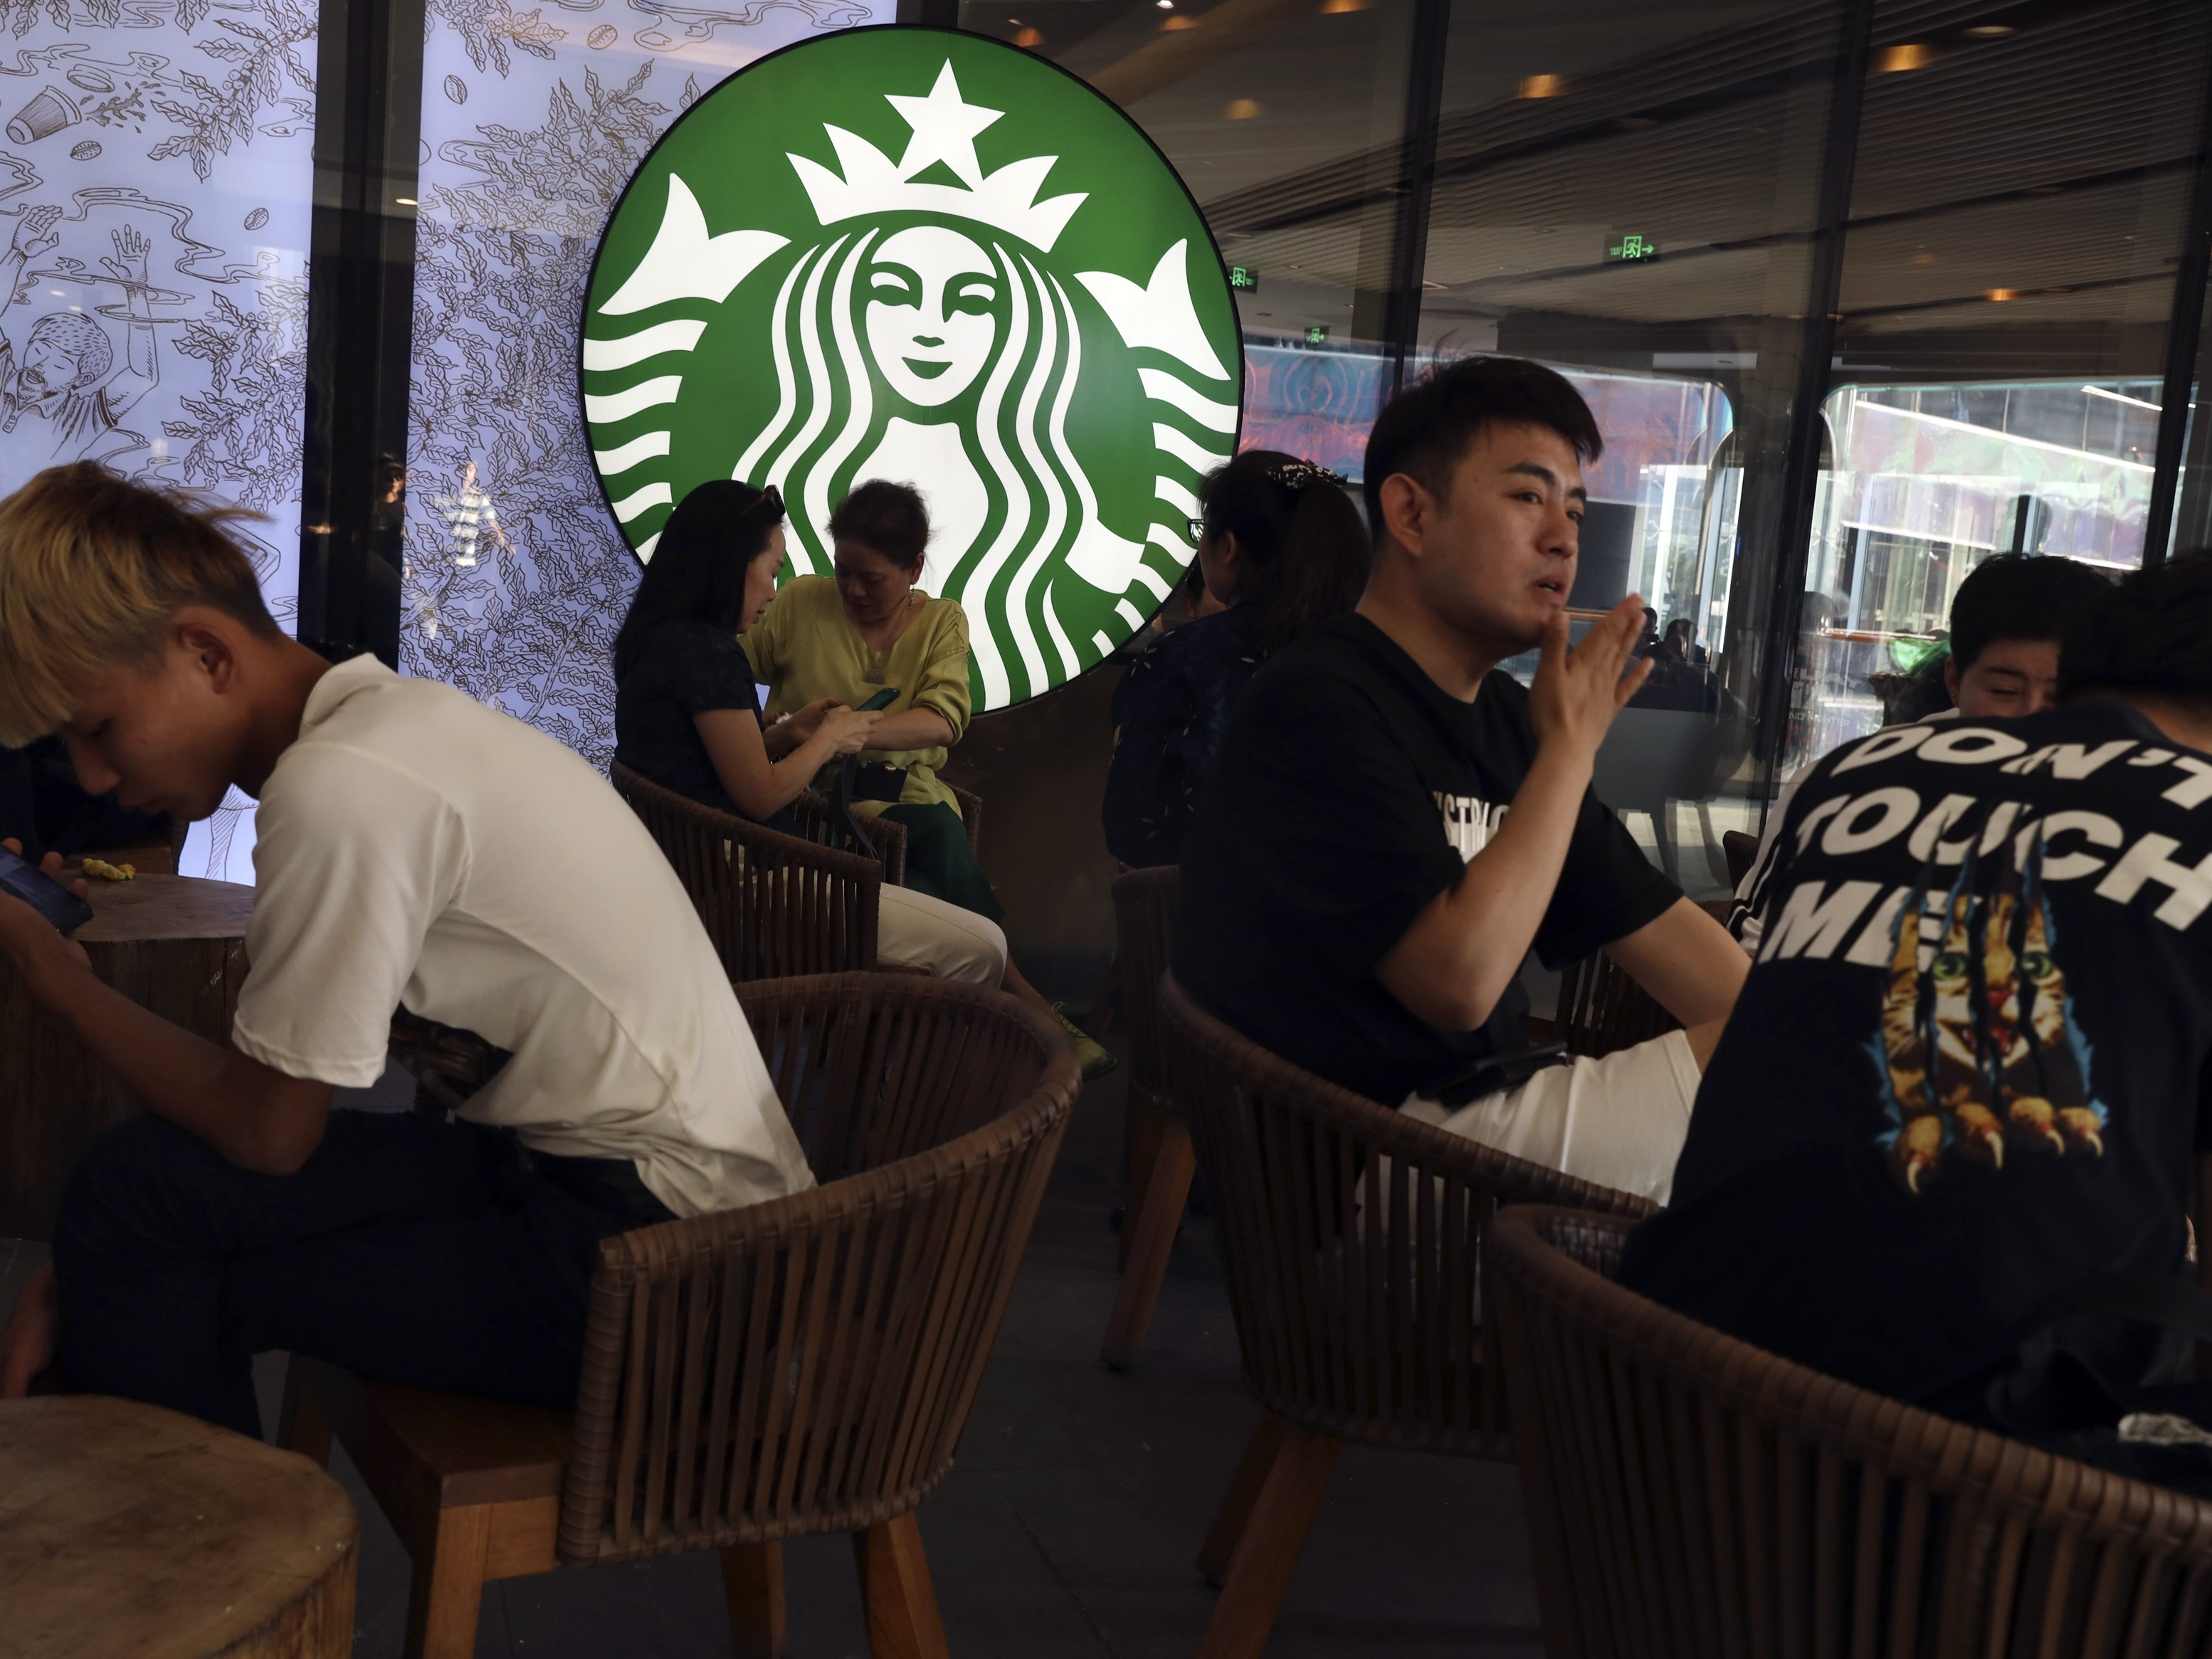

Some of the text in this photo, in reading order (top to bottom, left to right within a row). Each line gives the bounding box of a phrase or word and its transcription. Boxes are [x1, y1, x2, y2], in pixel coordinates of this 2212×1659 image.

[1829, 725, 2212, 810] DON'T
[1791, 785, 2212, 932] TOUCH
[1757, 879, 1984, 974] ME
